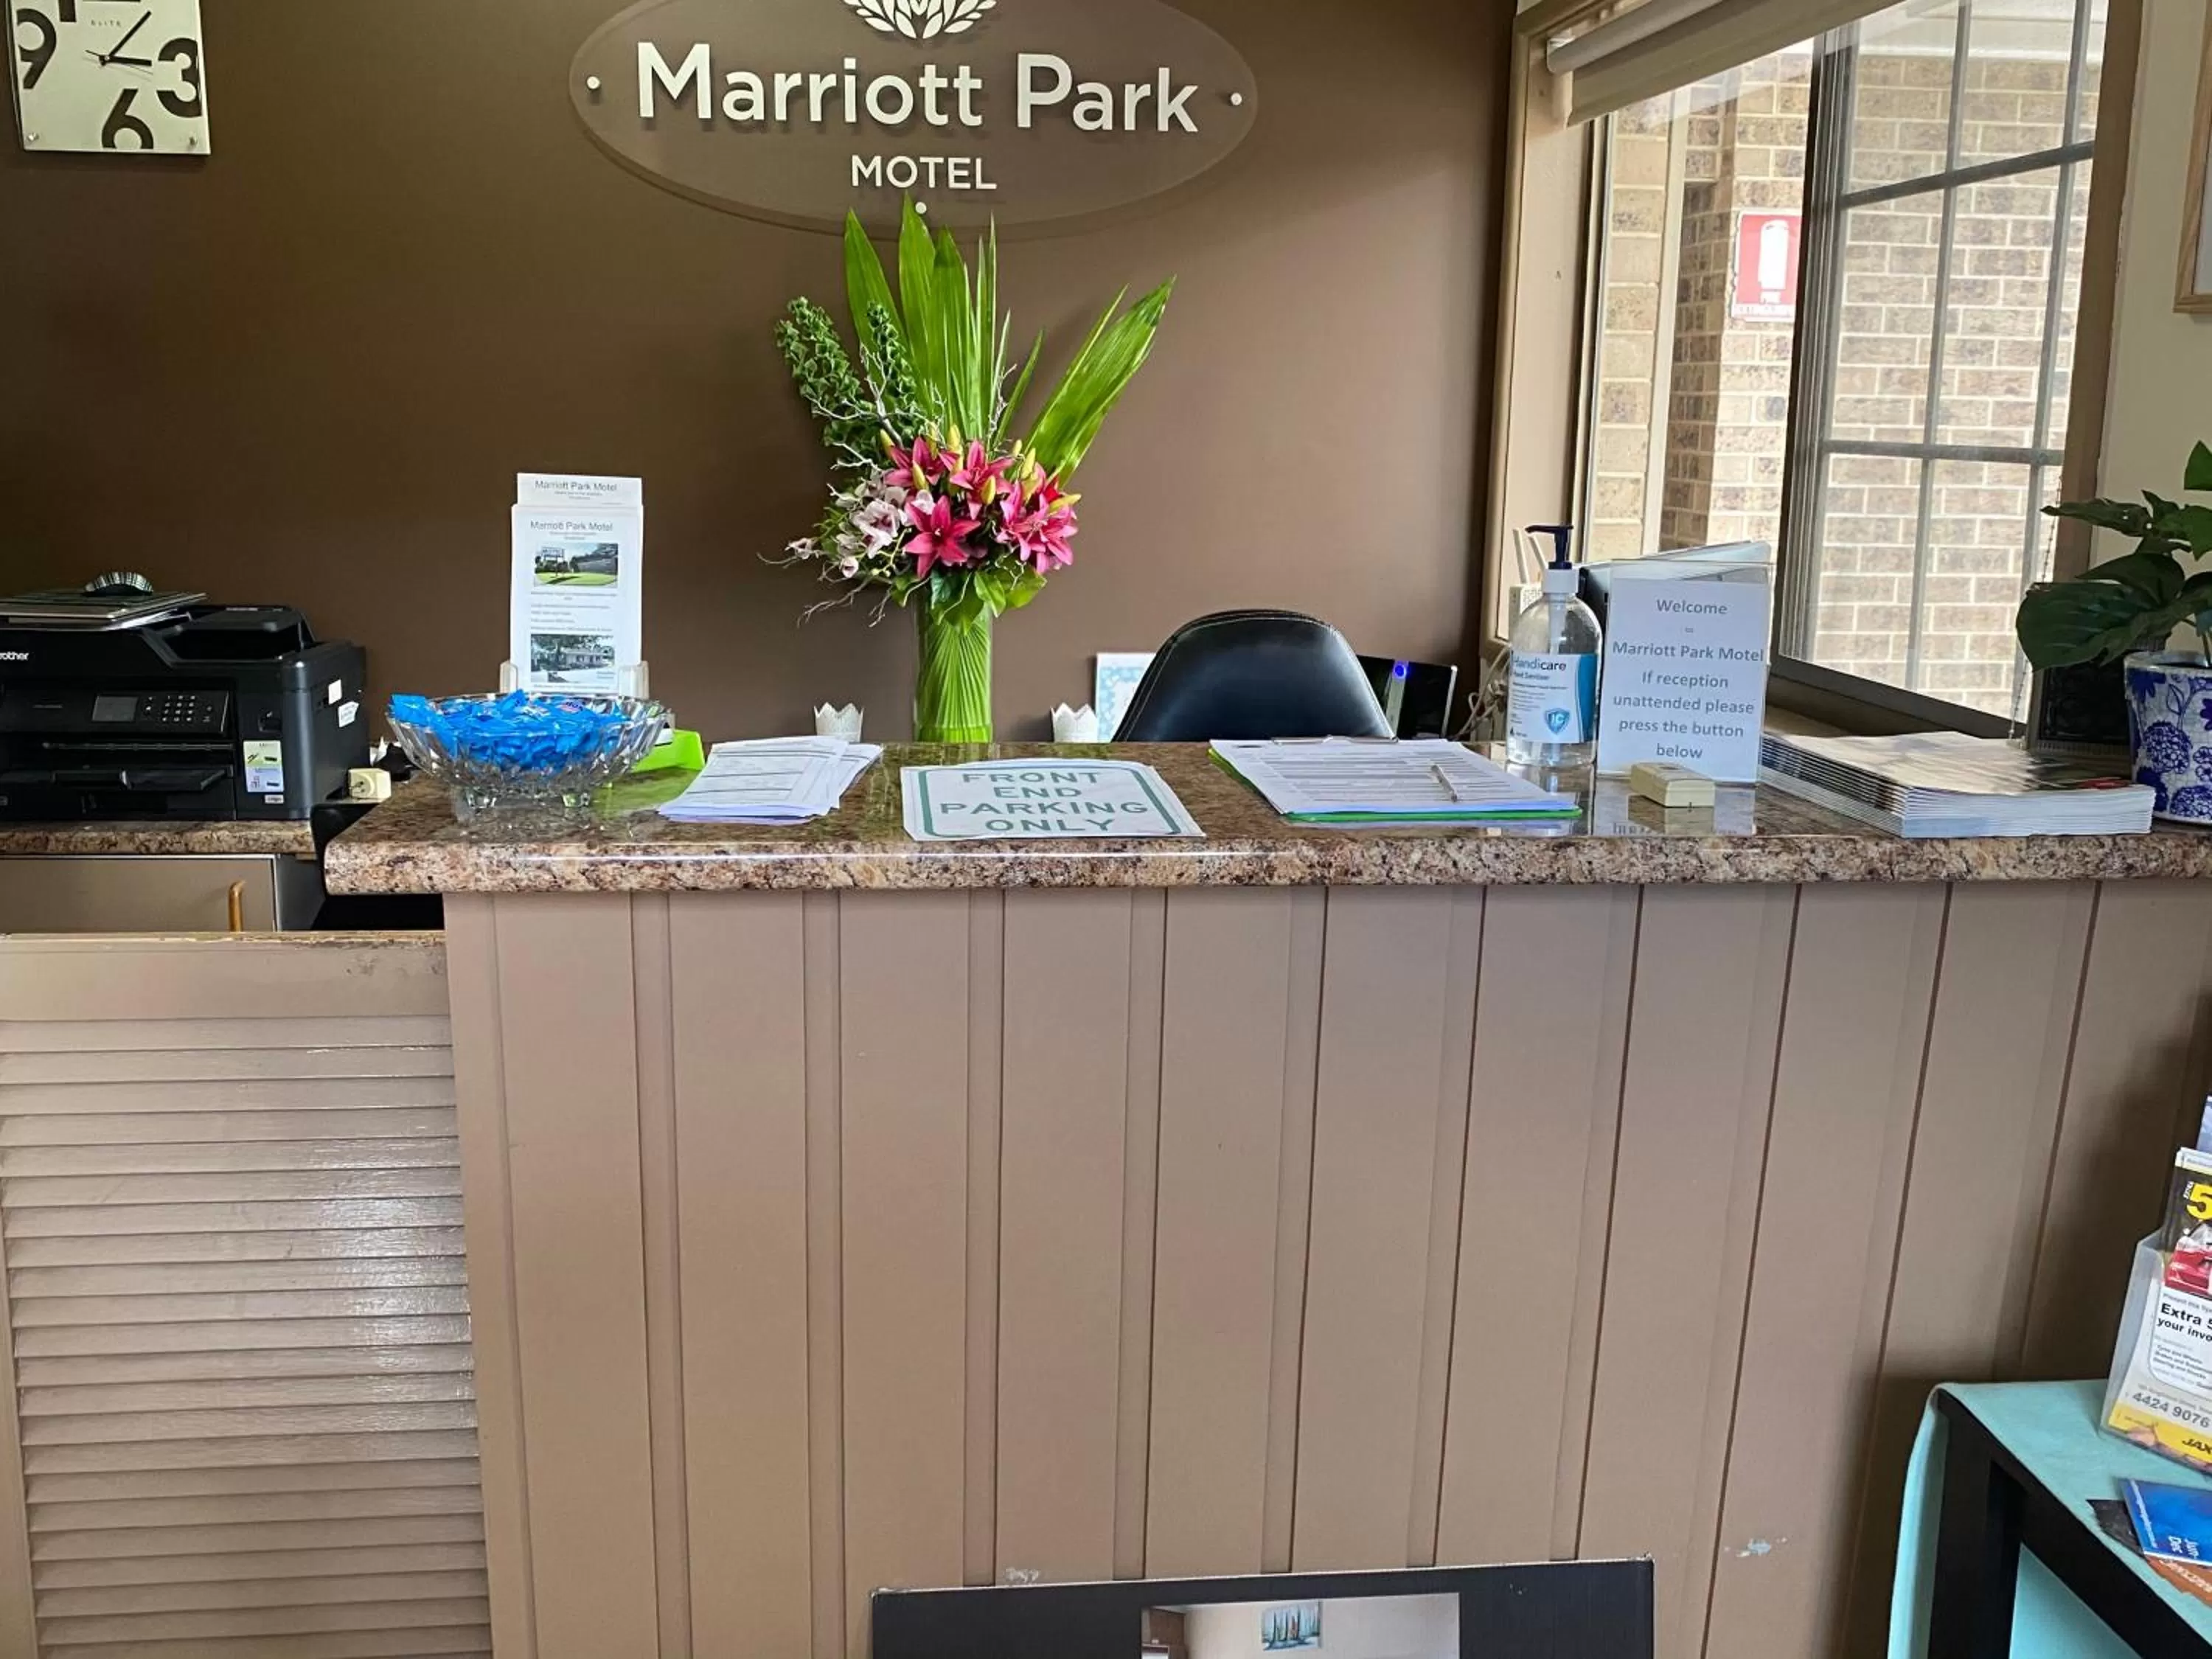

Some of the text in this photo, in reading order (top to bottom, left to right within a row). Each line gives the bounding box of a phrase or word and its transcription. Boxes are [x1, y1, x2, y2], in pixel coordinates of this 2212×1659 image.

[16, 8, 57, 89] 9
[156, 38, 202, 118] 3
[638, 41, 1199, 133] Marriott Park
[101, 88, 154, 149] 6
[851, 156, 997, 189] MOTEL
[1657, 599, 1728, 614] Welcome
[1613, 641, 1764, 661] Marriott Park Motel
[1642, 669, 1729, 689] If reception
[1613, 695, 1755, 714] unattended please
[1619, 720, 1744, 737] press the button
[1657, 743, 1703, 759] below
[962, 772, 1099, 784] FRONT
[993, 787, 1082, 799] END
[940, 801, 1149, 815] PARKING
[986, 818, 1117, 832] ONLY
[2161, 1302, 2202, 1326] Extra
[2157, 1318, 2184, 1332] your
[2132, 1392, 2169, 1412] 4424
[2172, 1406, 2211, 1427] 9076
